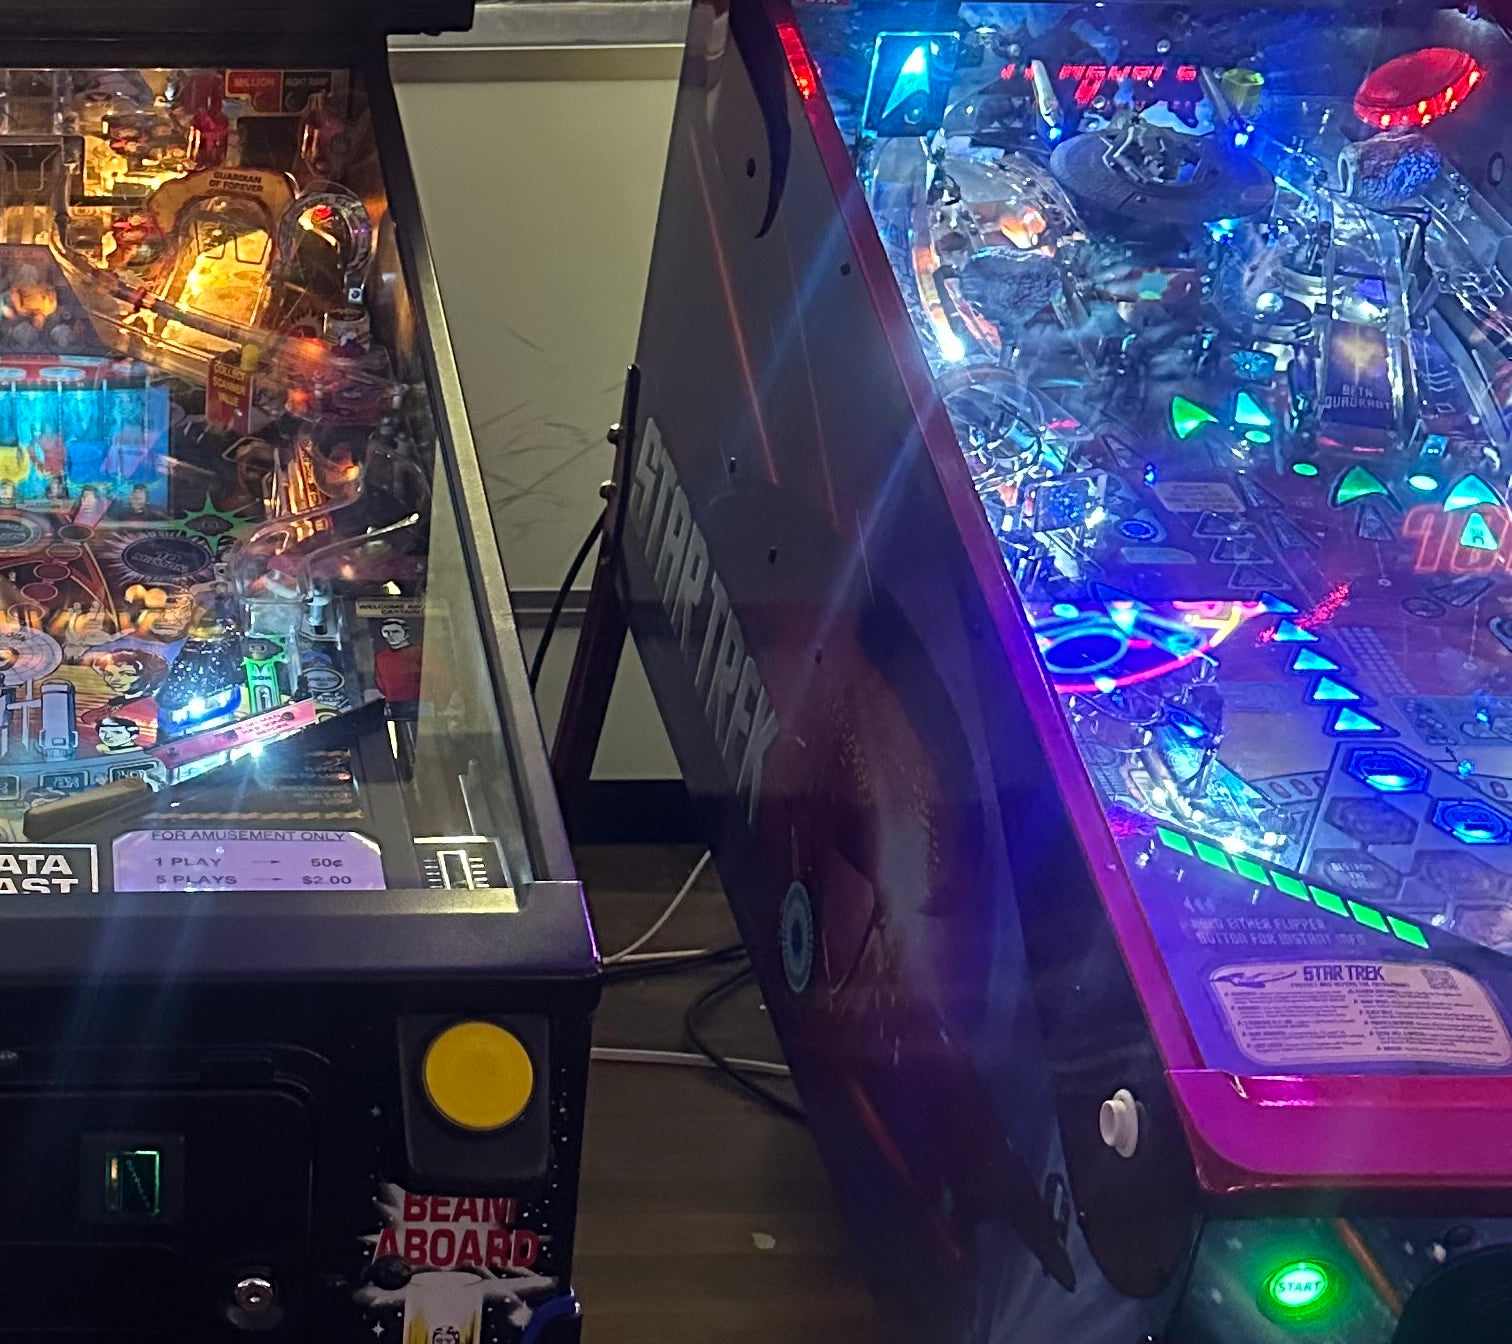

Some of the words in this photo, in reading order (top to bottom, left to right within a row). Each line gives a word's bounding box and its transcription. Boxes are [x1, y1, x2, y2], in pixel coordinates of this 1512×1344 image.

[213, 171, 262, 184] GUARDIAN
[209, 179, 221, 188] OF
[223, 181, 264, 193] FOREVER
[631, 418, 710, 652] STAR
[694, 570, 779, 806] TREK
[151, 830, 186, 842] FOR
[191, 830, 296, 842] AMUSEMENT
[300, 831, 346, 842] ONLY
[171, 858, 221, 866] PLAY
[310, 858, 343, 868] 50¢
[156, 876, 166, 885] 5
[174, 876, 237, 885] PLAYS
[1303, 966, 1345, 981] STAR
[1347, 966, 1384, 981] TREK
[372, 1228, 539, 1268] ABOARD
